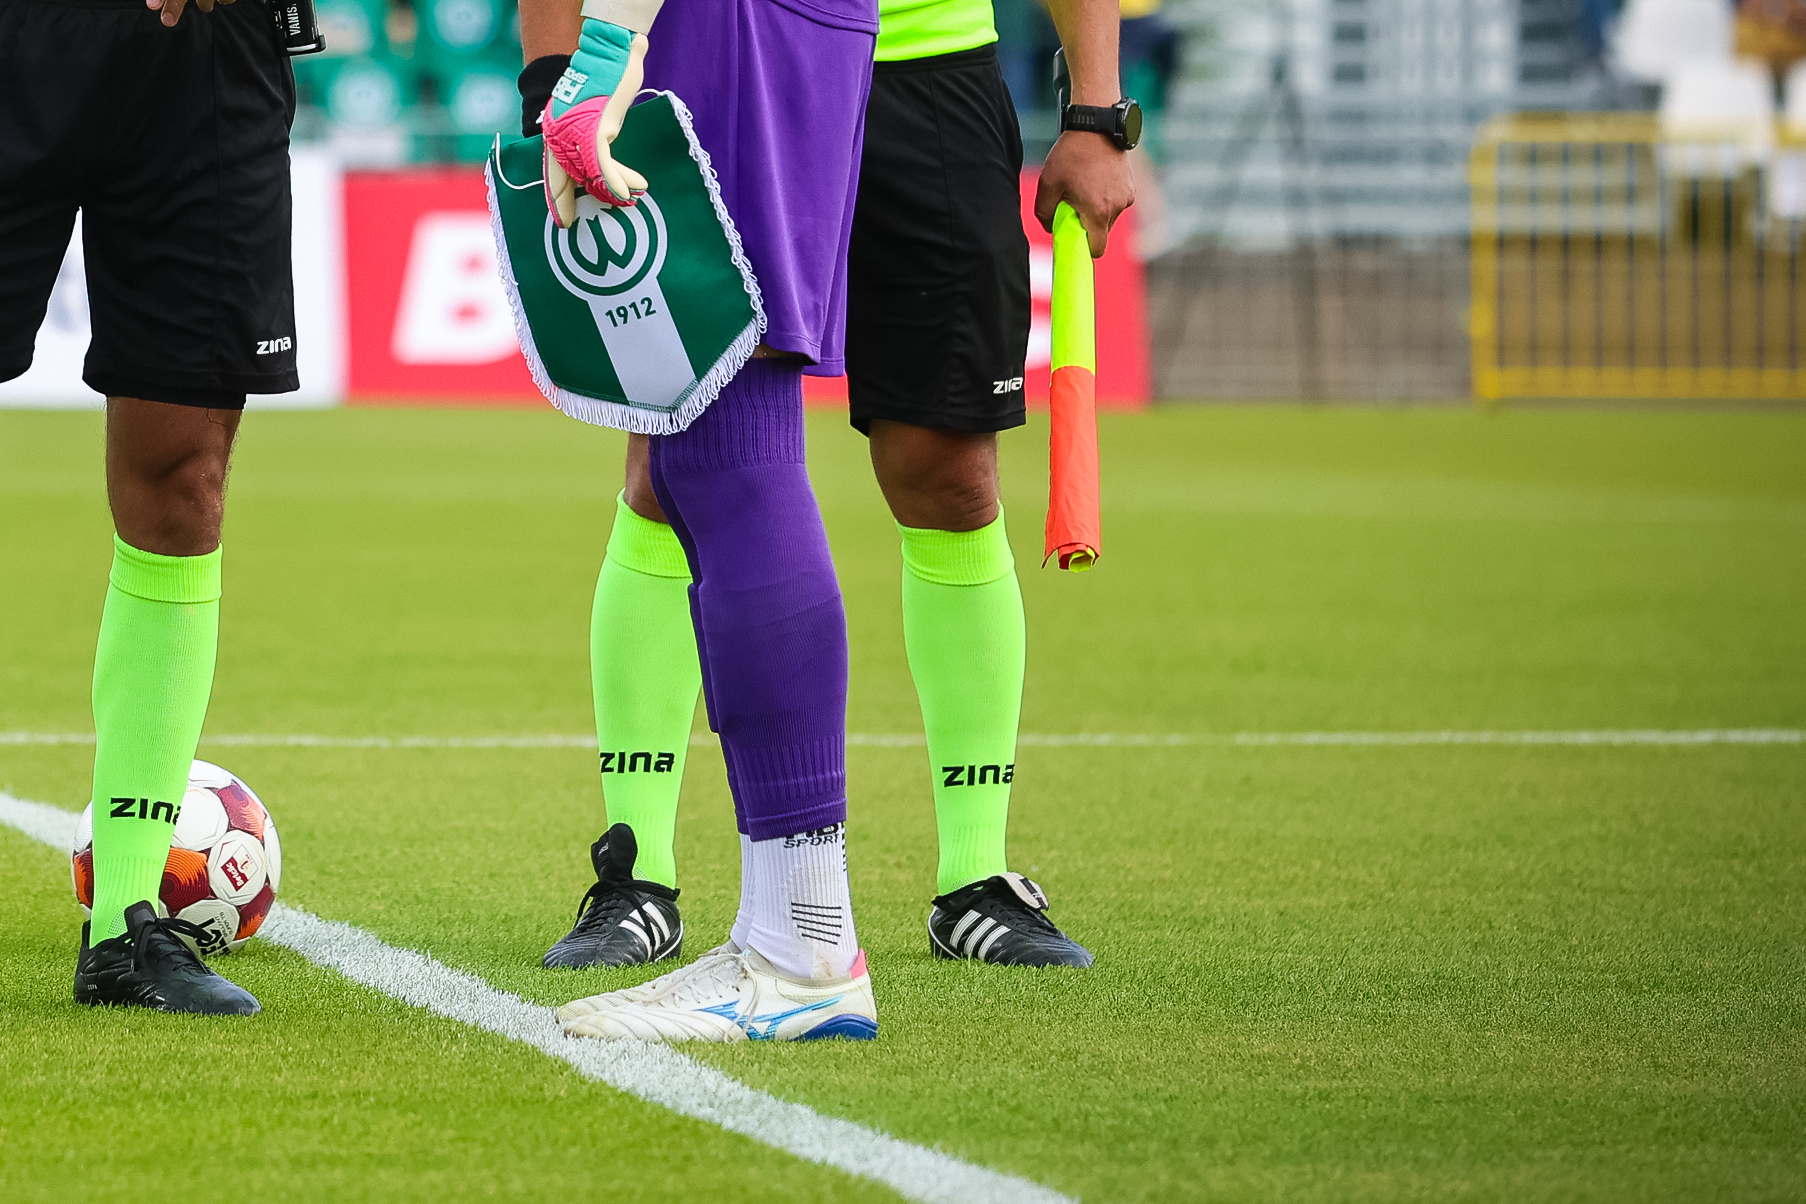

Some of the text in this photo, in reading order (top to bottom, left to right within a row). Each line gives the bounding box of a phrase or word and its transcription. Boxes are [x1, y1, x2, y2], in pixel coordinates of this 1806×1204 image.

[605, 296, 657, 328] 1912
[256, 336, 292, 355] zina
[599, 751, 676, 774] zina
[941, 763, 1016, 788] zina
[783, 833, 840, 849] SPORT
